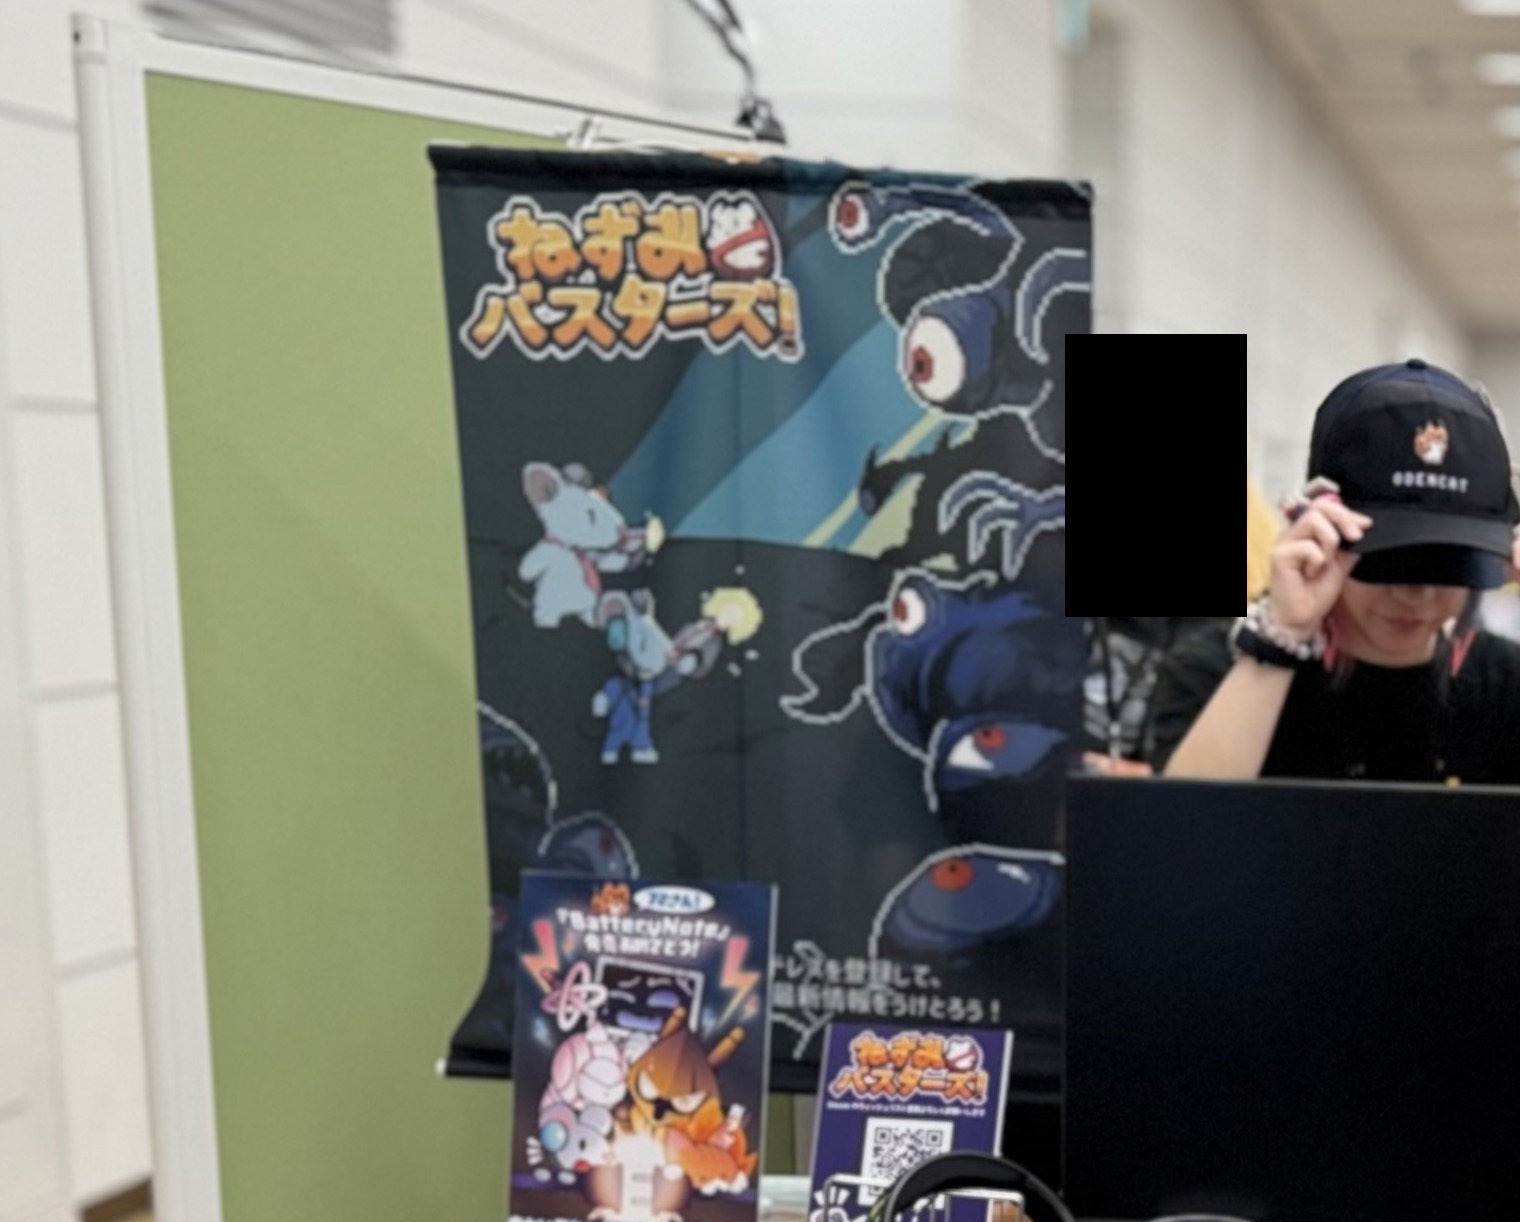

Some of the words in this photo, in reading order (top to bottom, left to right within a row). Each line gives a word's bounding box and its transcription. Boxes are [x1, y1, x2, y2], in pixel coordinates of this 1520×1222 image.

[492, 197, 706, 281] ねずみ
[466, 277, 801, 357] バスターズ!
[1392, 470, 1470, 493] ODENCAT
[854, 1032, 947, 1069] ねずみ
